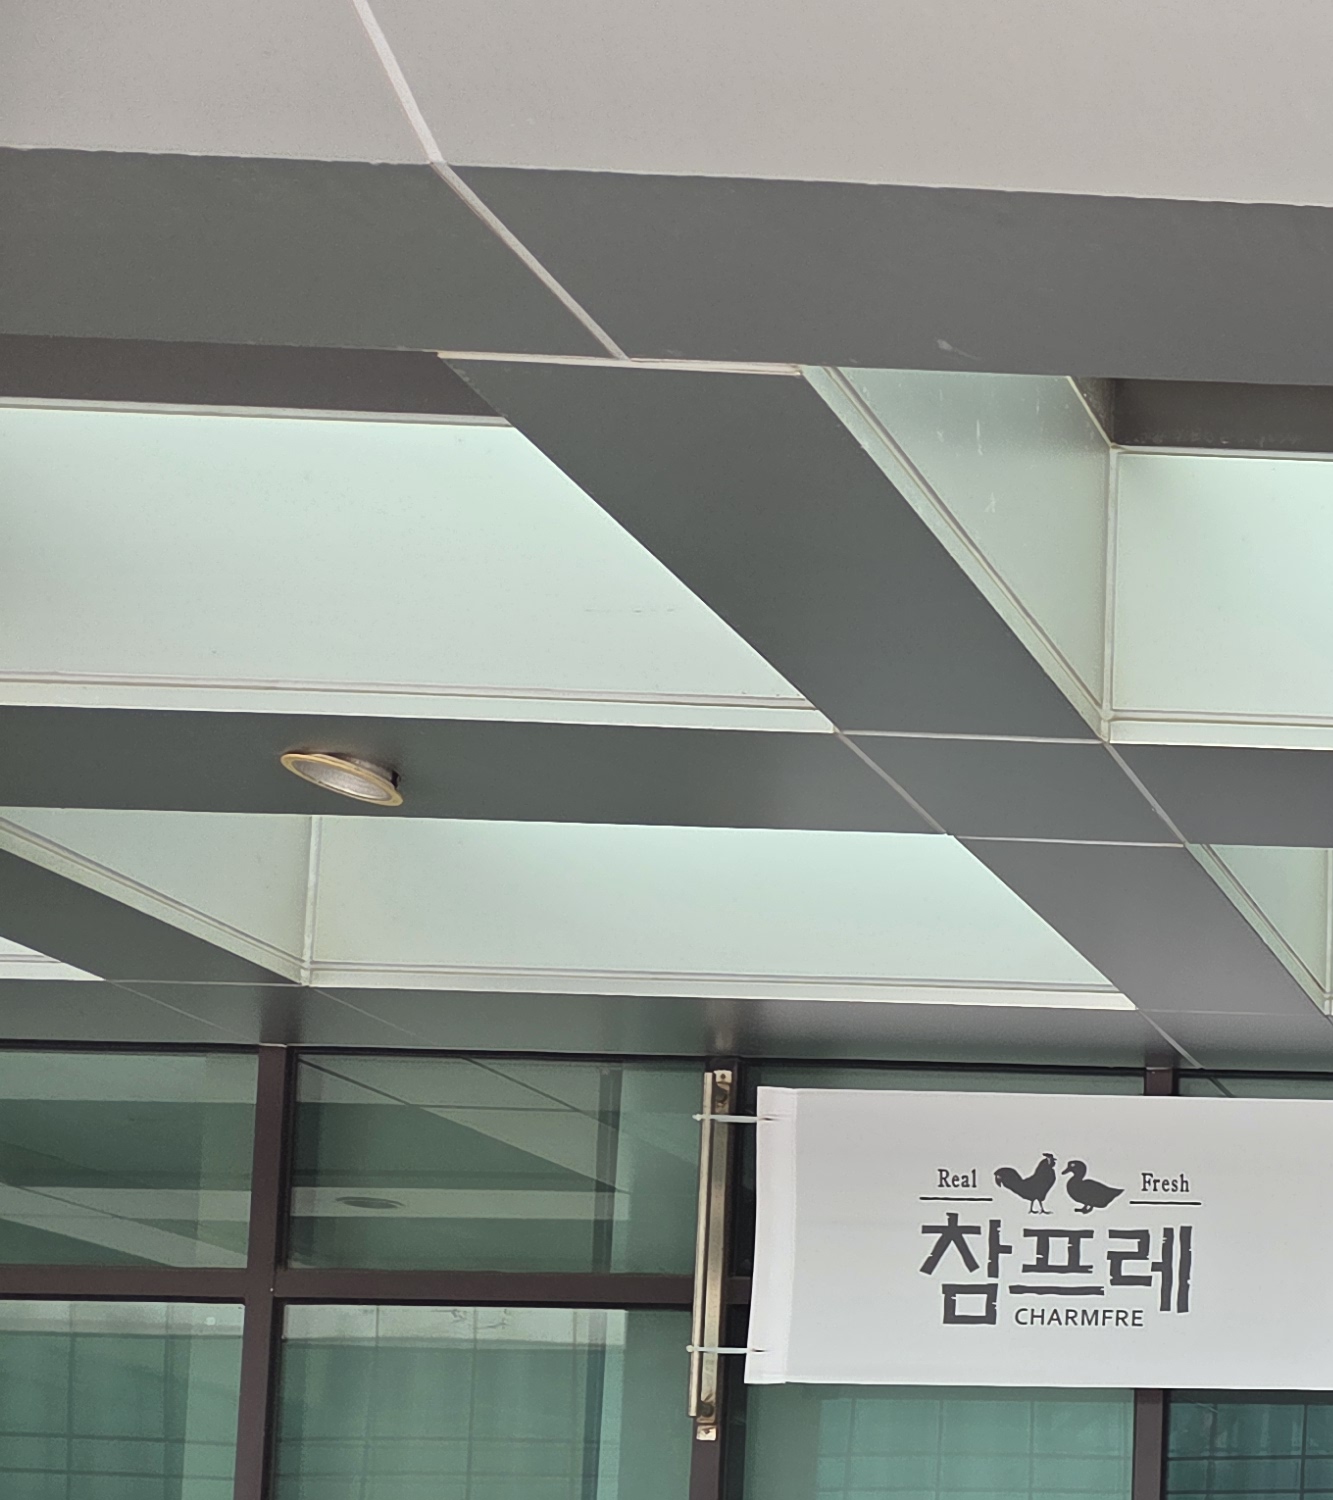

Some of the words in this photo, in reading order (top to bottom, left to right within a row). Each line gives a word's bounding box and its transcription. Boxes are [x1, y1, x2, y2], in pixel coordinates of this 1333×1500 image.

[937, 1168, 978, 1189] Real
[1141, 1172, 1190, 1193] Fresh
[919, 1212, 1193, 1326] 참프레
[1014, 1307, 1144, 1328] CHARMFRE
